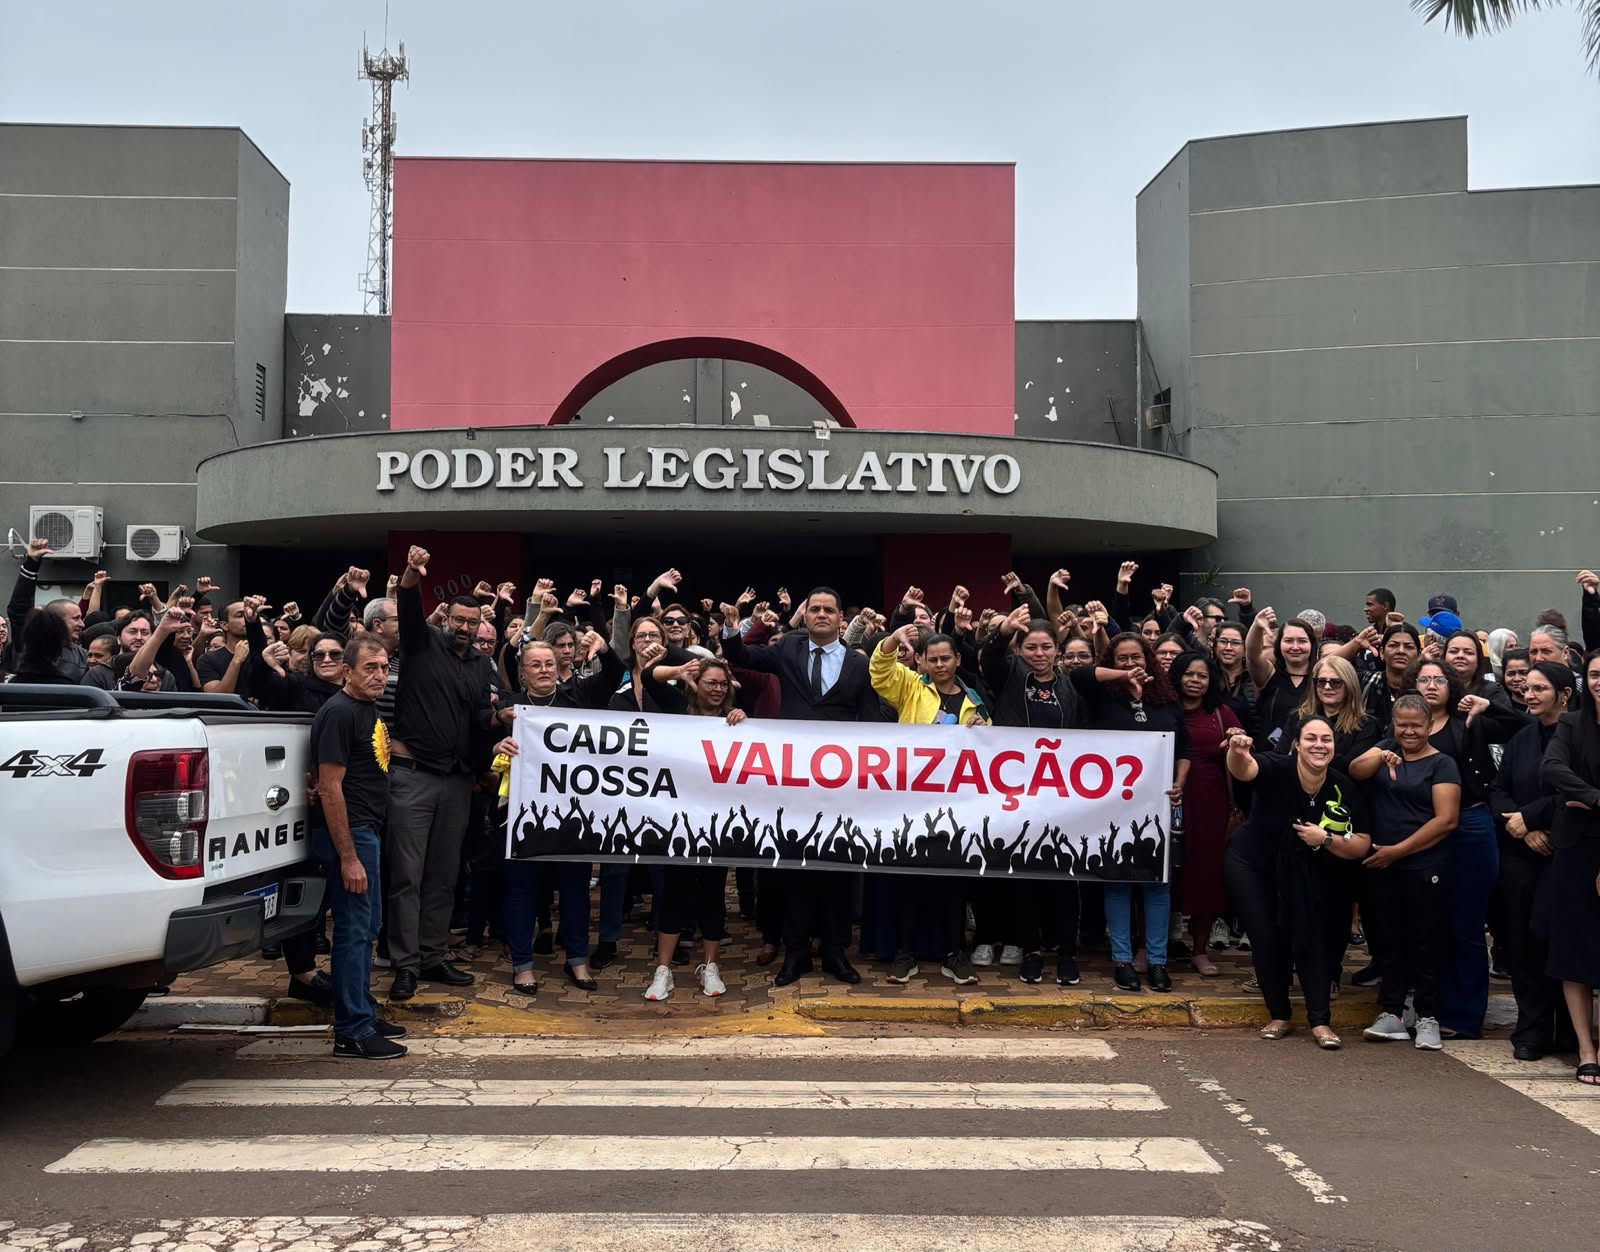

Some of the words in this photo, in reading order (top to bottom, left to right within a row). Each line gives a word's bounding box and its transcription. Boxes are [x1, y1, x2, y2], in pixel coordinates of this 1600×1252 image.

[377, 448, 584, 490] PODER
[603, 447, 1021, 494] LEGISLATIVO
[433, 574, 472, 600] 900
[543, 718, 650, 757] CADÊ
[540, 763, 678, 799] NOSSA
[701, 737, 1143, 811] VALORIZAÇÃO?
[208, 819, 305, 862] RANGE
